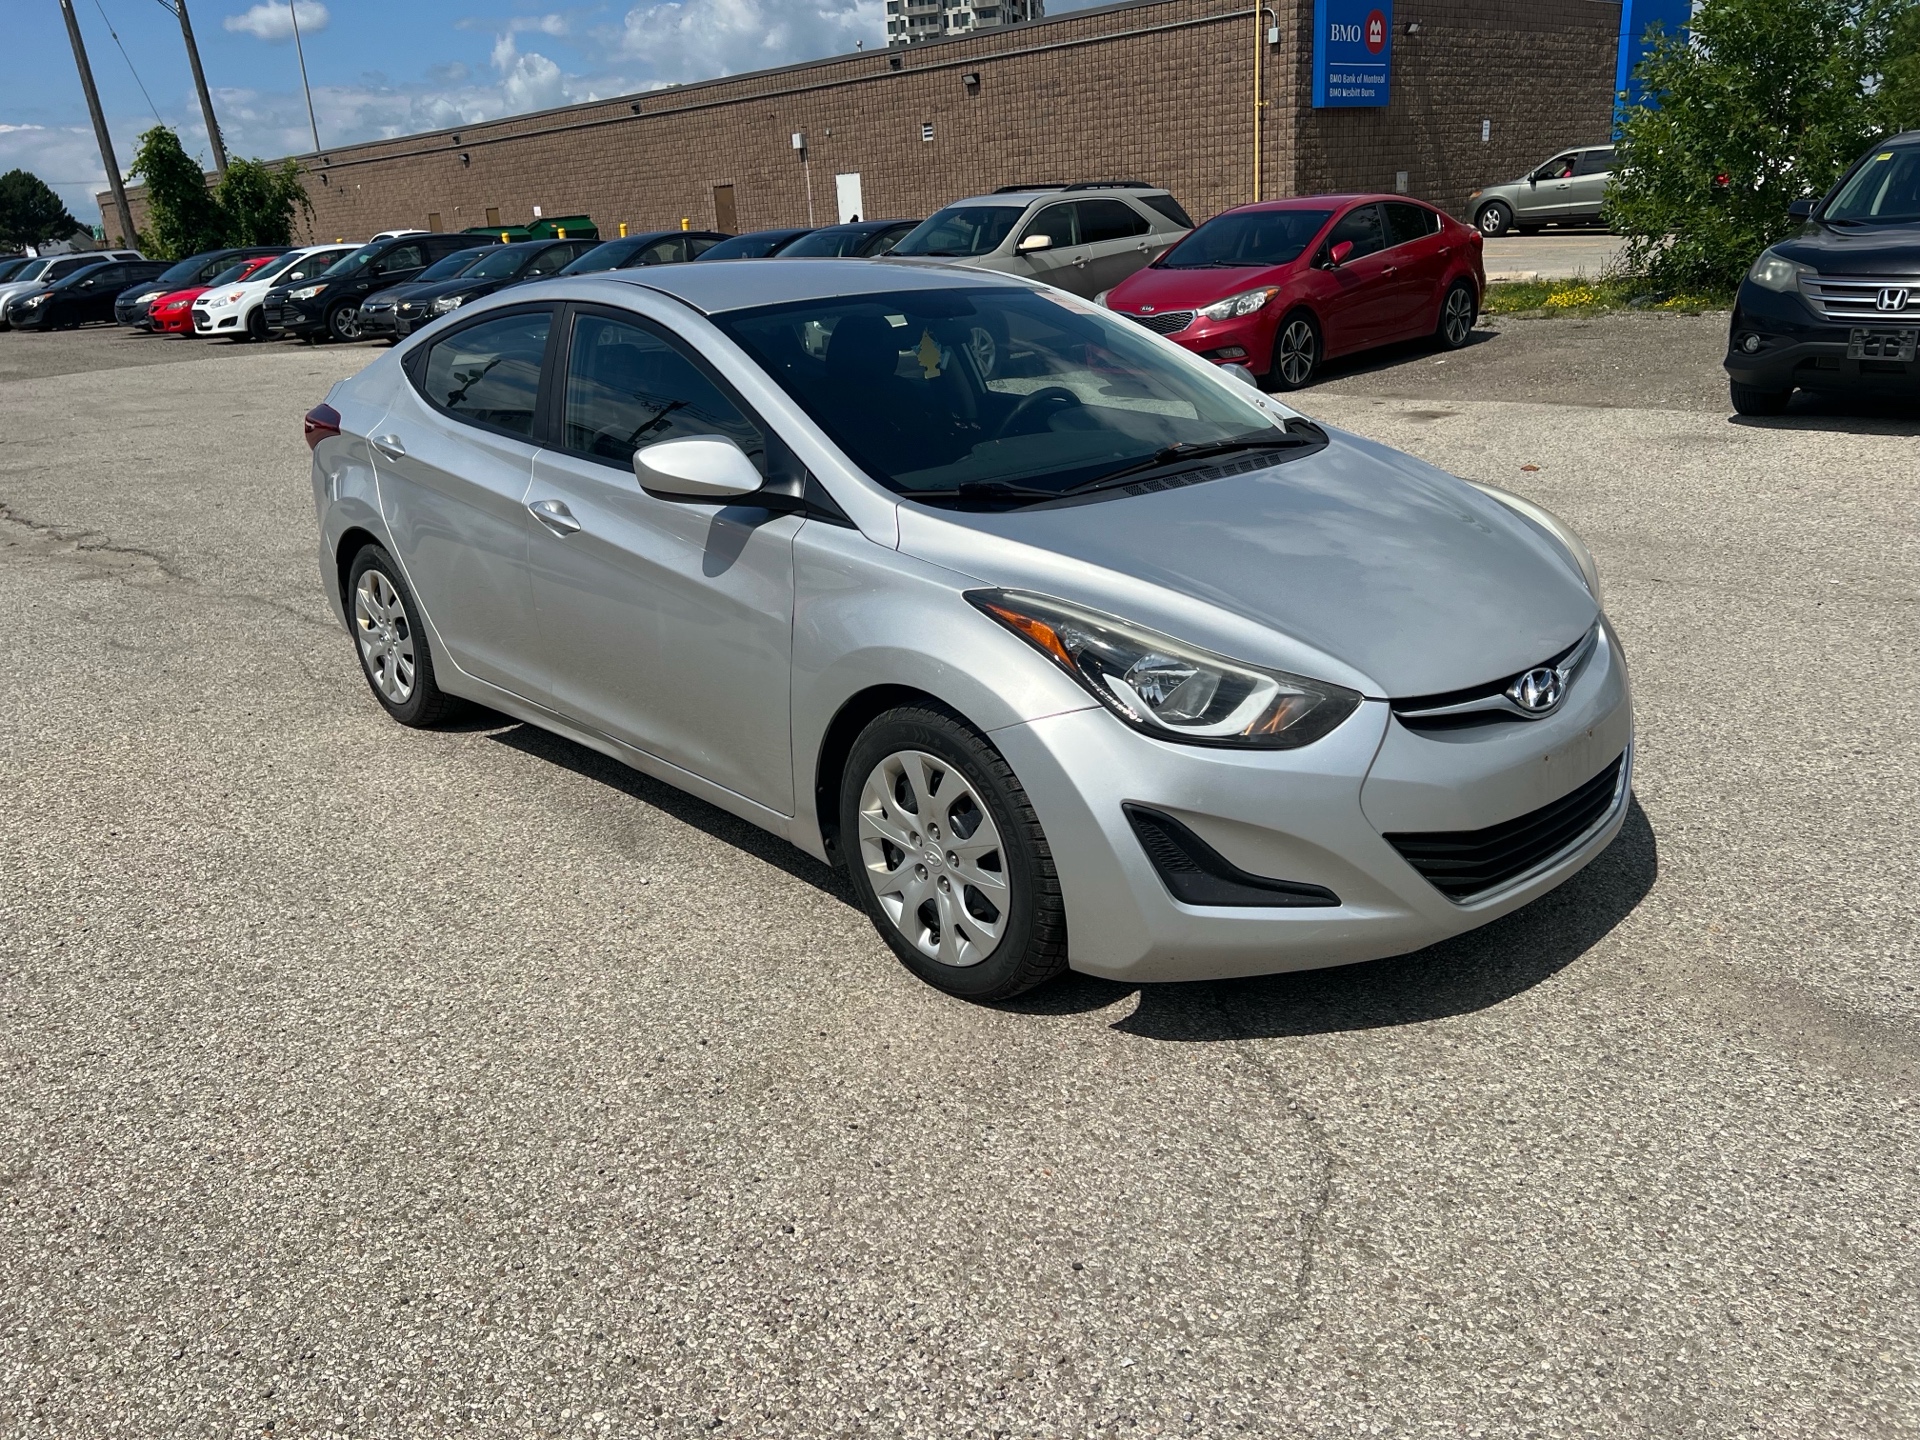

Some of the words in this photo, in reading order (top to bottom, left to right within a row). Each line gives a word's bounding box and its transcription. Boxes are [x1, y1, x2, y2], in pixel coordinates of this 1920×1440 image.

[1331, 24, 1360, 42] BMO
[1330, 74, 1342, 83] BMO
[1343, 73, 1355, 83] Bank
[1357, 73, 1362, 83] of
[1363, 73, 1385, 83] Montreal
[1330, 88, 1341, 96] BMO
[1342, 87, 1360, 96] Nesbitt
[1361, 88, 1375, 96] Burns
